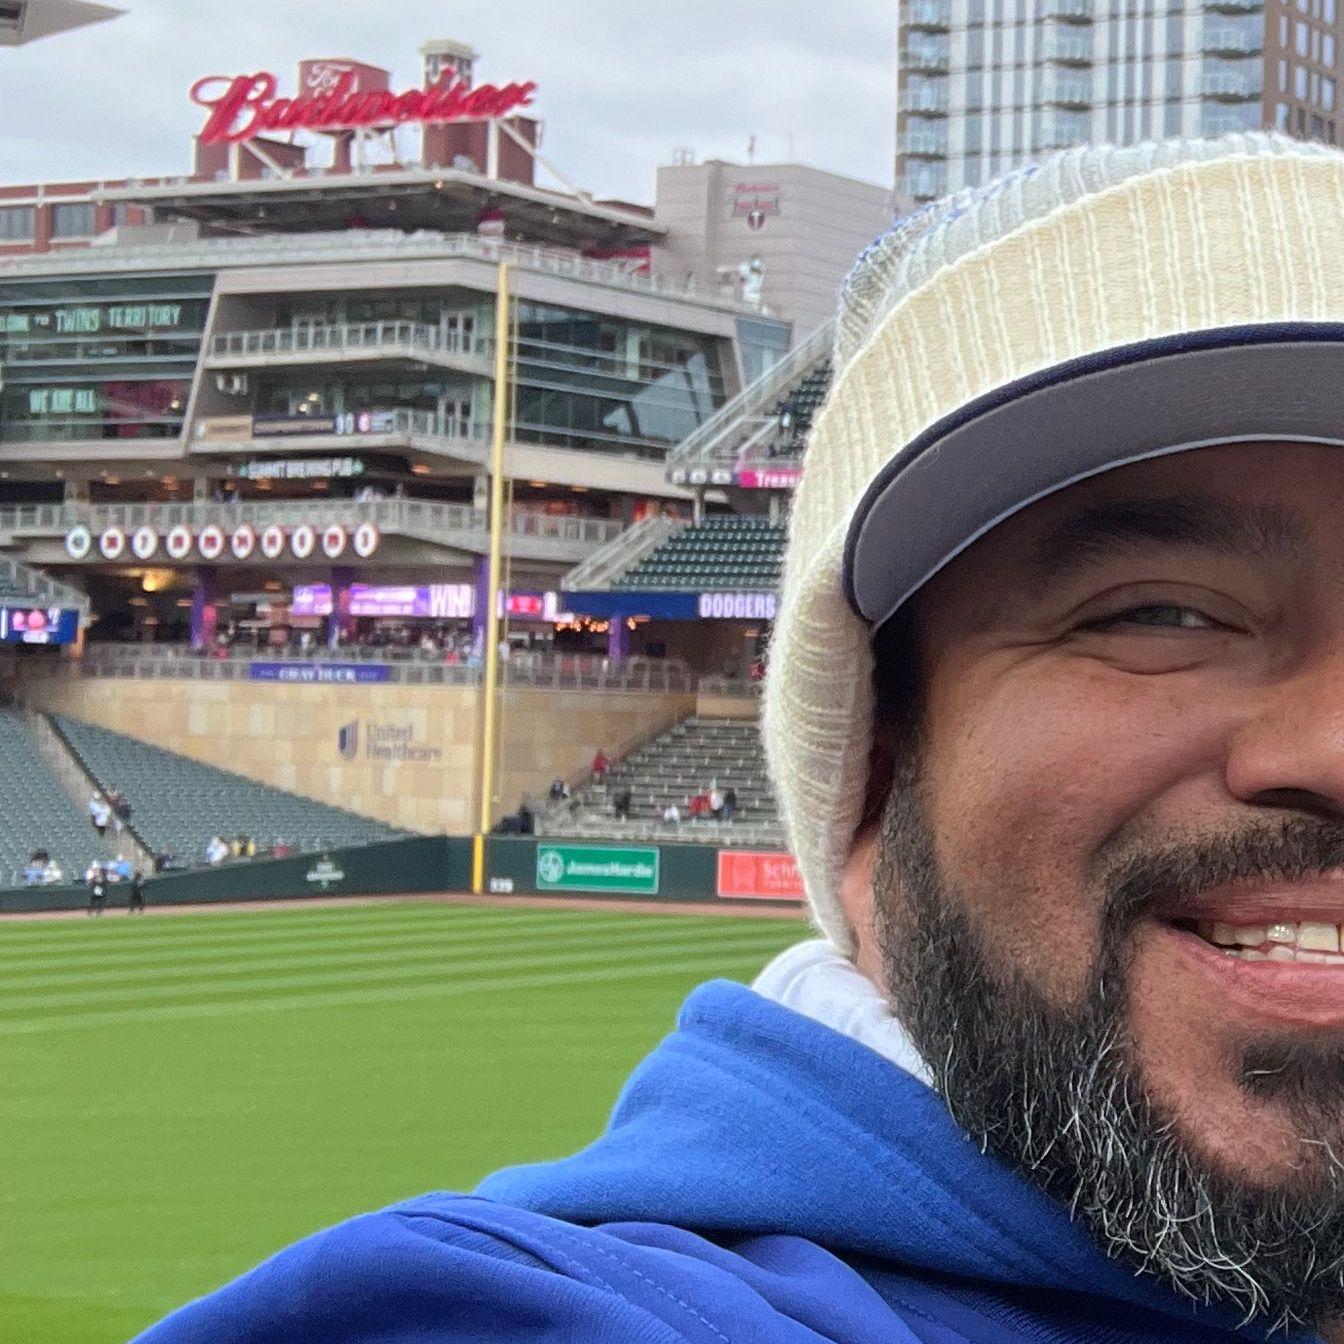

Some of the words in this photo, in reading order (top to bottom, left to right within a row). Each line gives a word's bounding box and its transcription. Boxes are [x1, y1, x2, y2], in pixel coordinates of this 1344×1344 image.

[189, 72, 538, 145] Budweiser
[55, 308, 100, 333] TWINS
[700, 593, 776, 618] DODGERS
